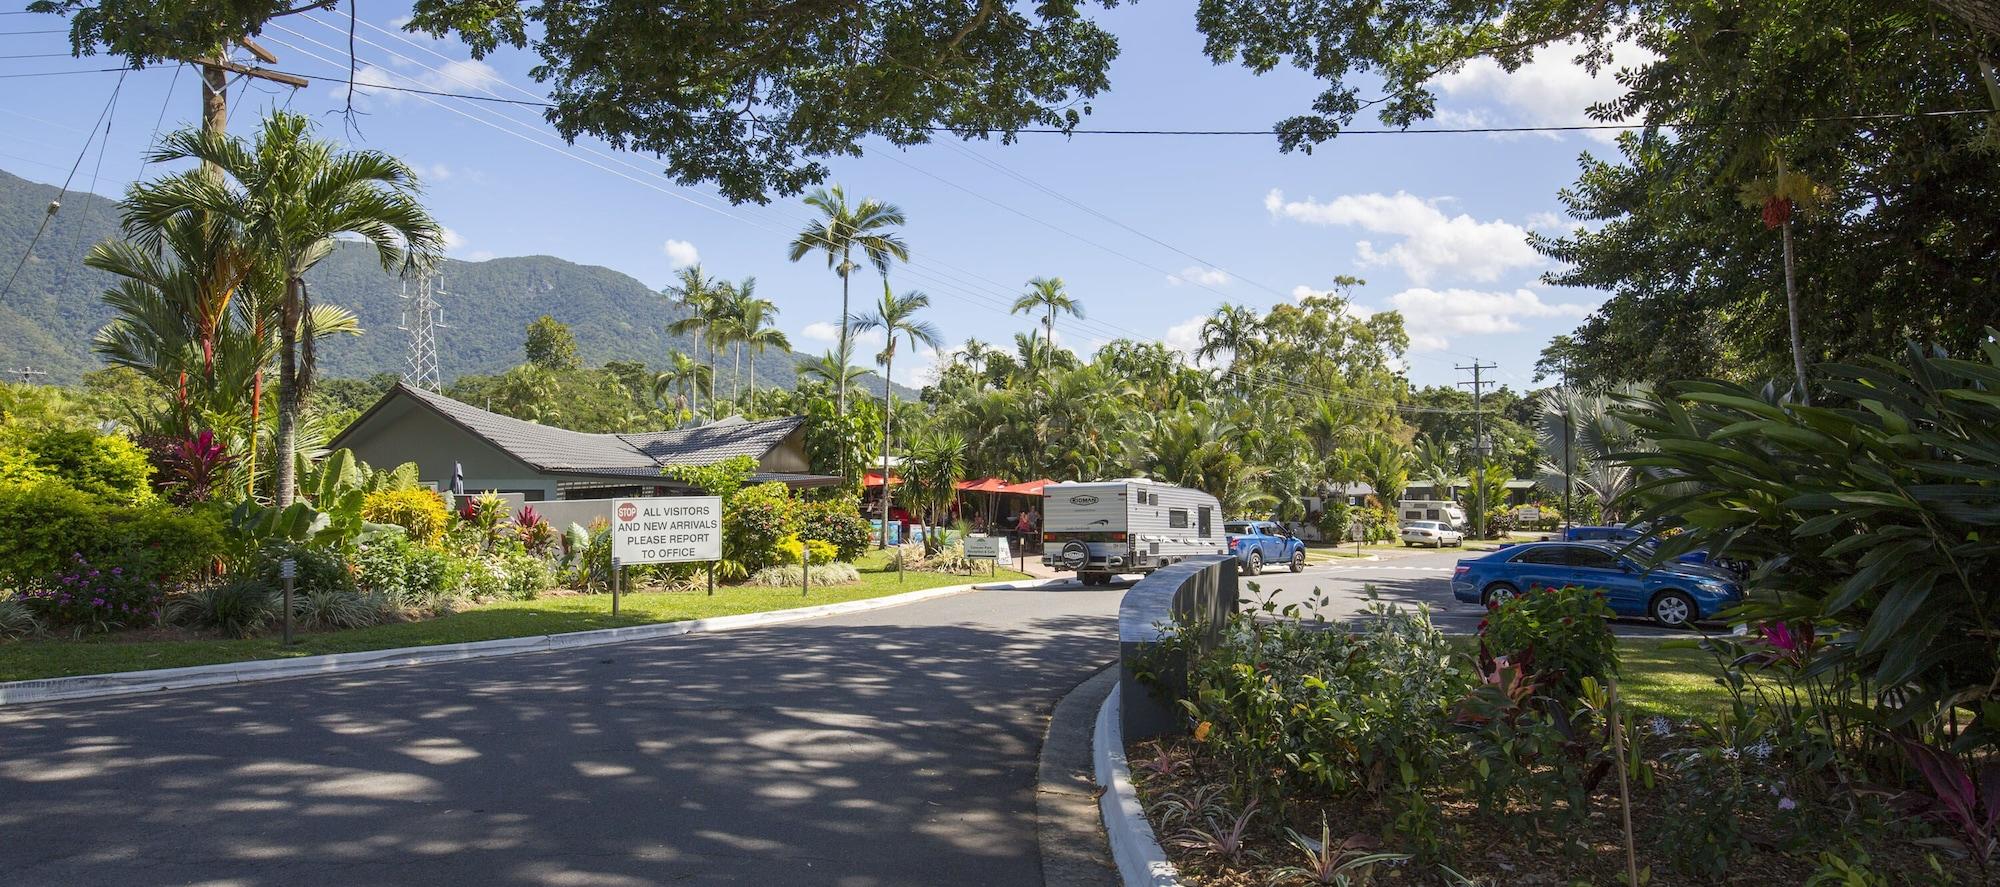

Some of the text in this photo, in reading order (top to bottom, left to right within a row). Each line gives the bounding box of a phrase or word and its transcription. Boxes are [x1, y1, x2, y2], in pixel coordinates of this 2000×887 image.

[618, 507, 636, 517] STOP
[643, 506, 710, 517] ALL VISITORS
[618, 520, 718, 532] AND NEW ARRIVALS
[627, 533, 710, 545] PLEASE REPORT
[642, 547, 696, 559] TO OFFICE
